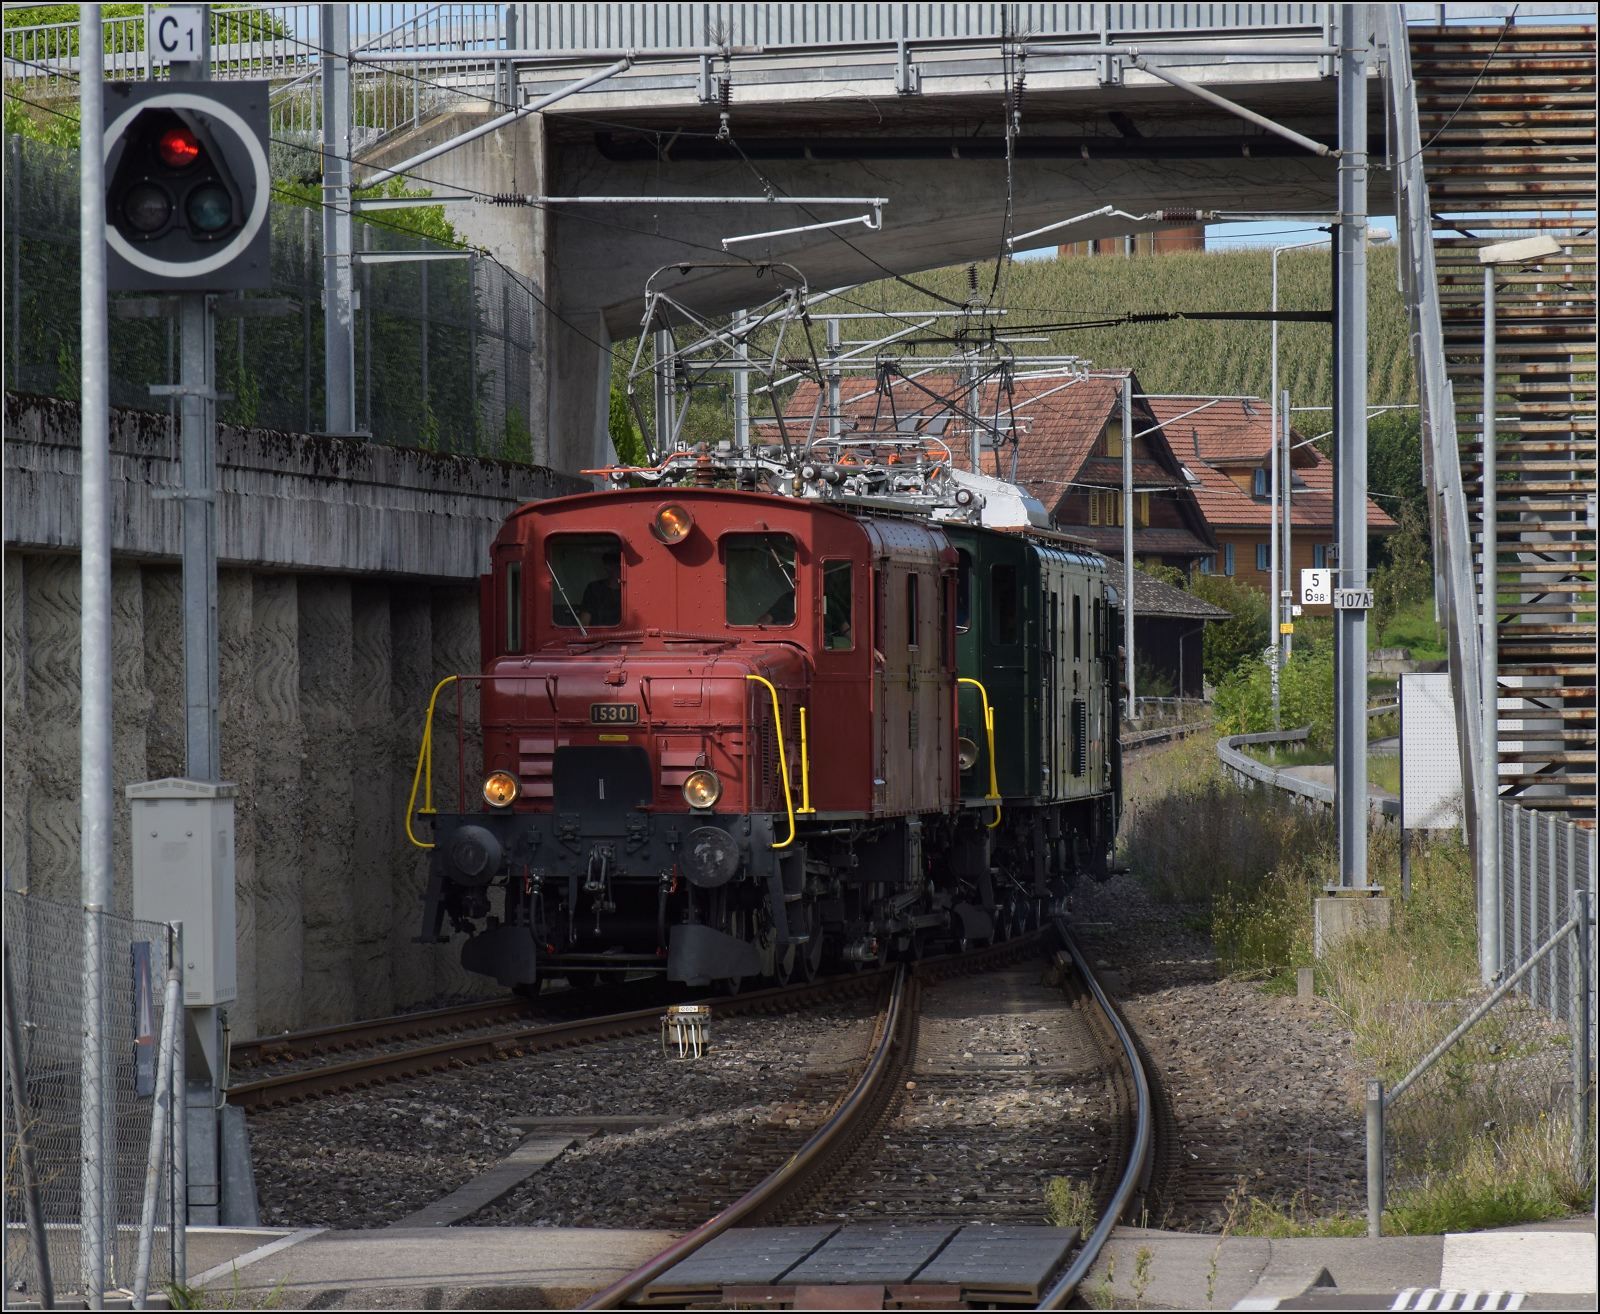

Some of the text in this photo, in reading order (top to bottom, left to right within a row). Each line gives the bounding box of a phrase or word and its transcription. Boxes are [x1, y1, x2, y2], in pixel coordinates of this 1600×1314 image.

[1312, 573, 1320, 587] 5
[1340, 593, 1370, 607] 107A
[594, 707, 634, 720] 15301
